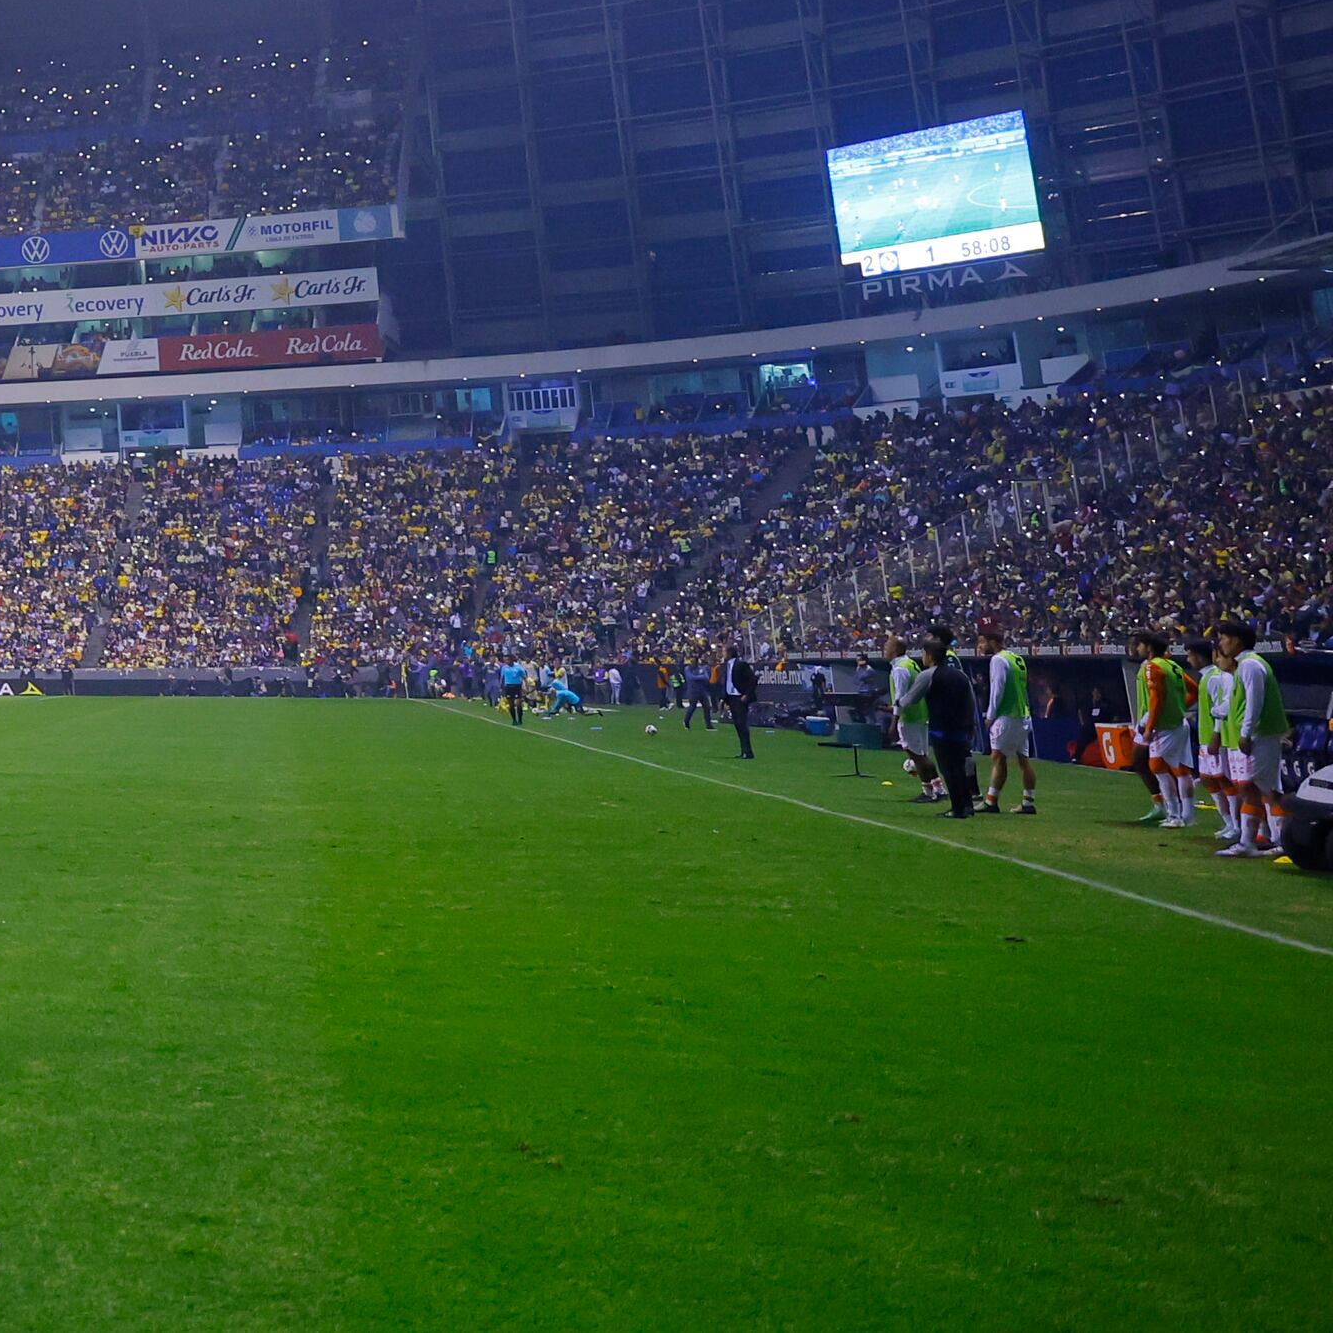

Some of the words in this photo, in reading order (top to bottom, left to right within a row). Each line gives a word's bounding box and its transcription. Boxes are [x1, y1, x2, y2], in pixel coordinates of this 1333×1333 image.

[260, 220, 334, 236] MOTORFIL
[961, 235, 1012, 258] 58:08
[185, 285, 231, 307] Carl's
[293, 276, 338, 299] Carl's
[861, 266, 985, 301] PIRMA
